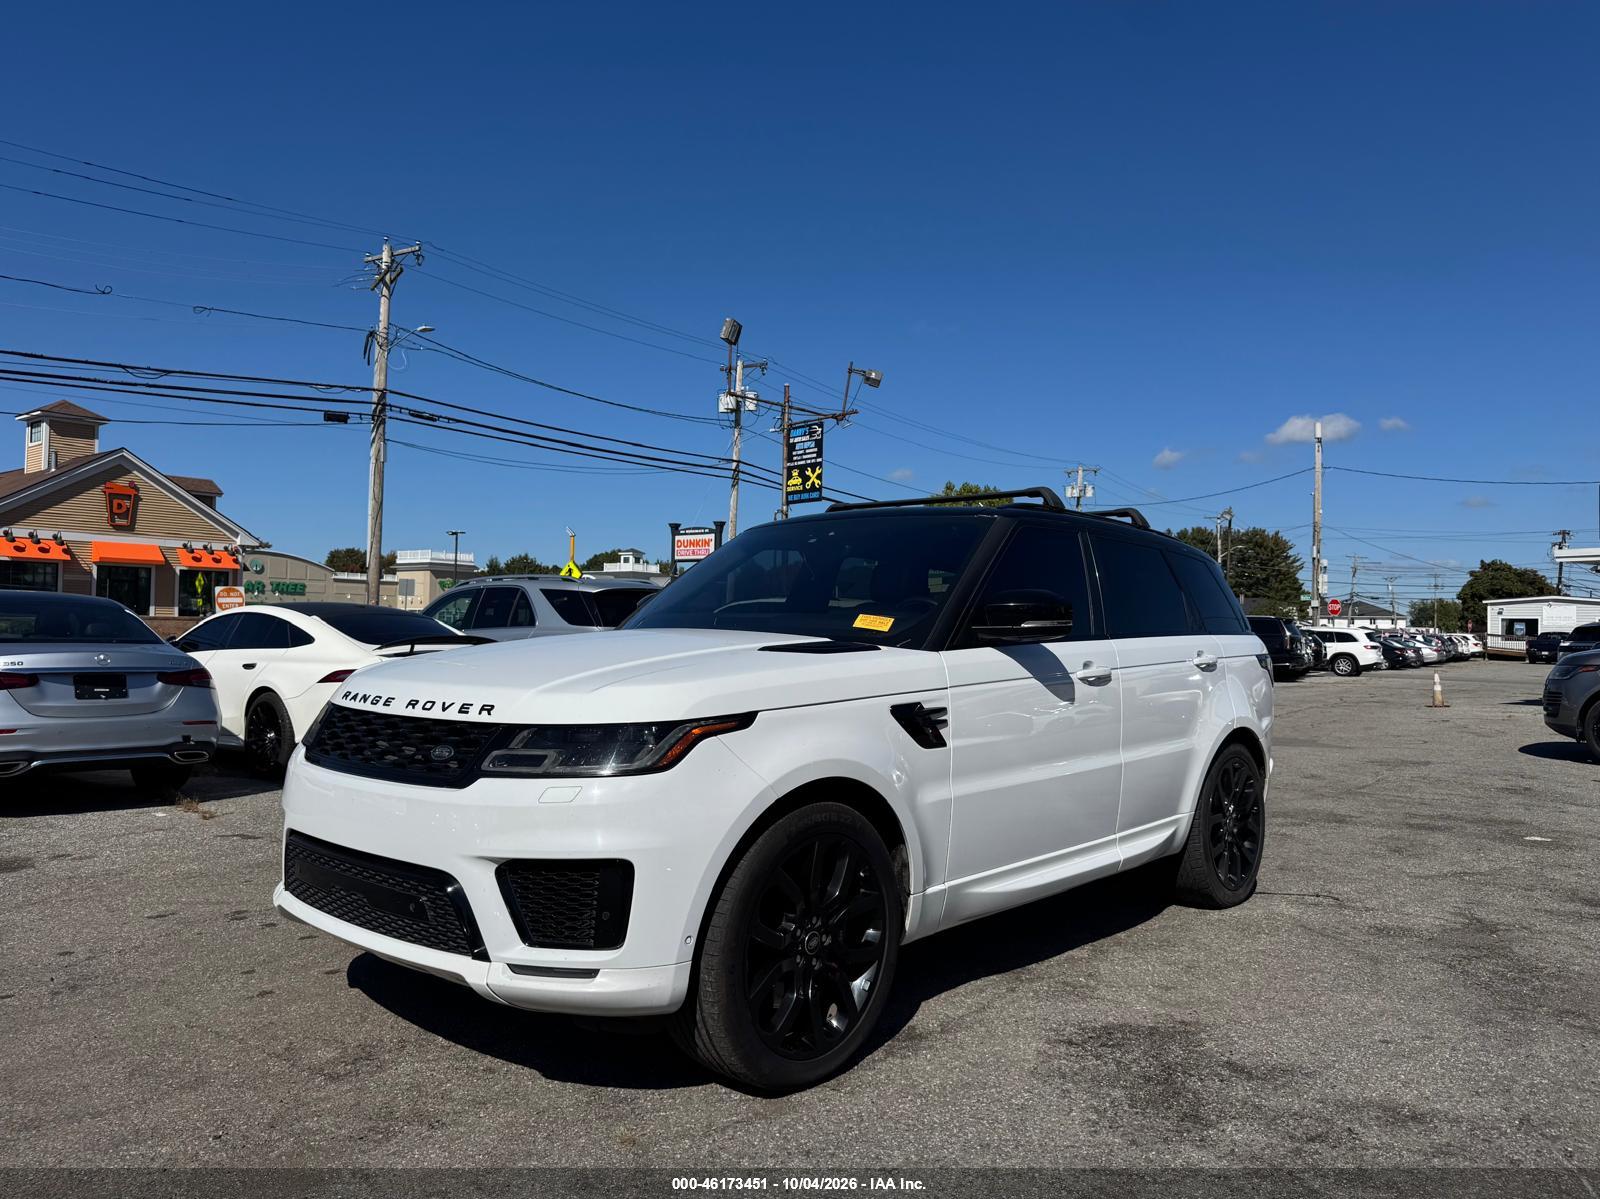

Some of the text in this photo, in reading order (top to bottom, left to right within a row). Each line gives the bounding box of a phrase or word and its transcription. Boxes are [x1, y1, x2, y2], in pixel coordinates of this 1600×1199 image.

[676, 538, 713, 548] DUNKIN'
[270, 581, 306, 596] TREE
[341, 690, 496, 716] RANGE ROVER
